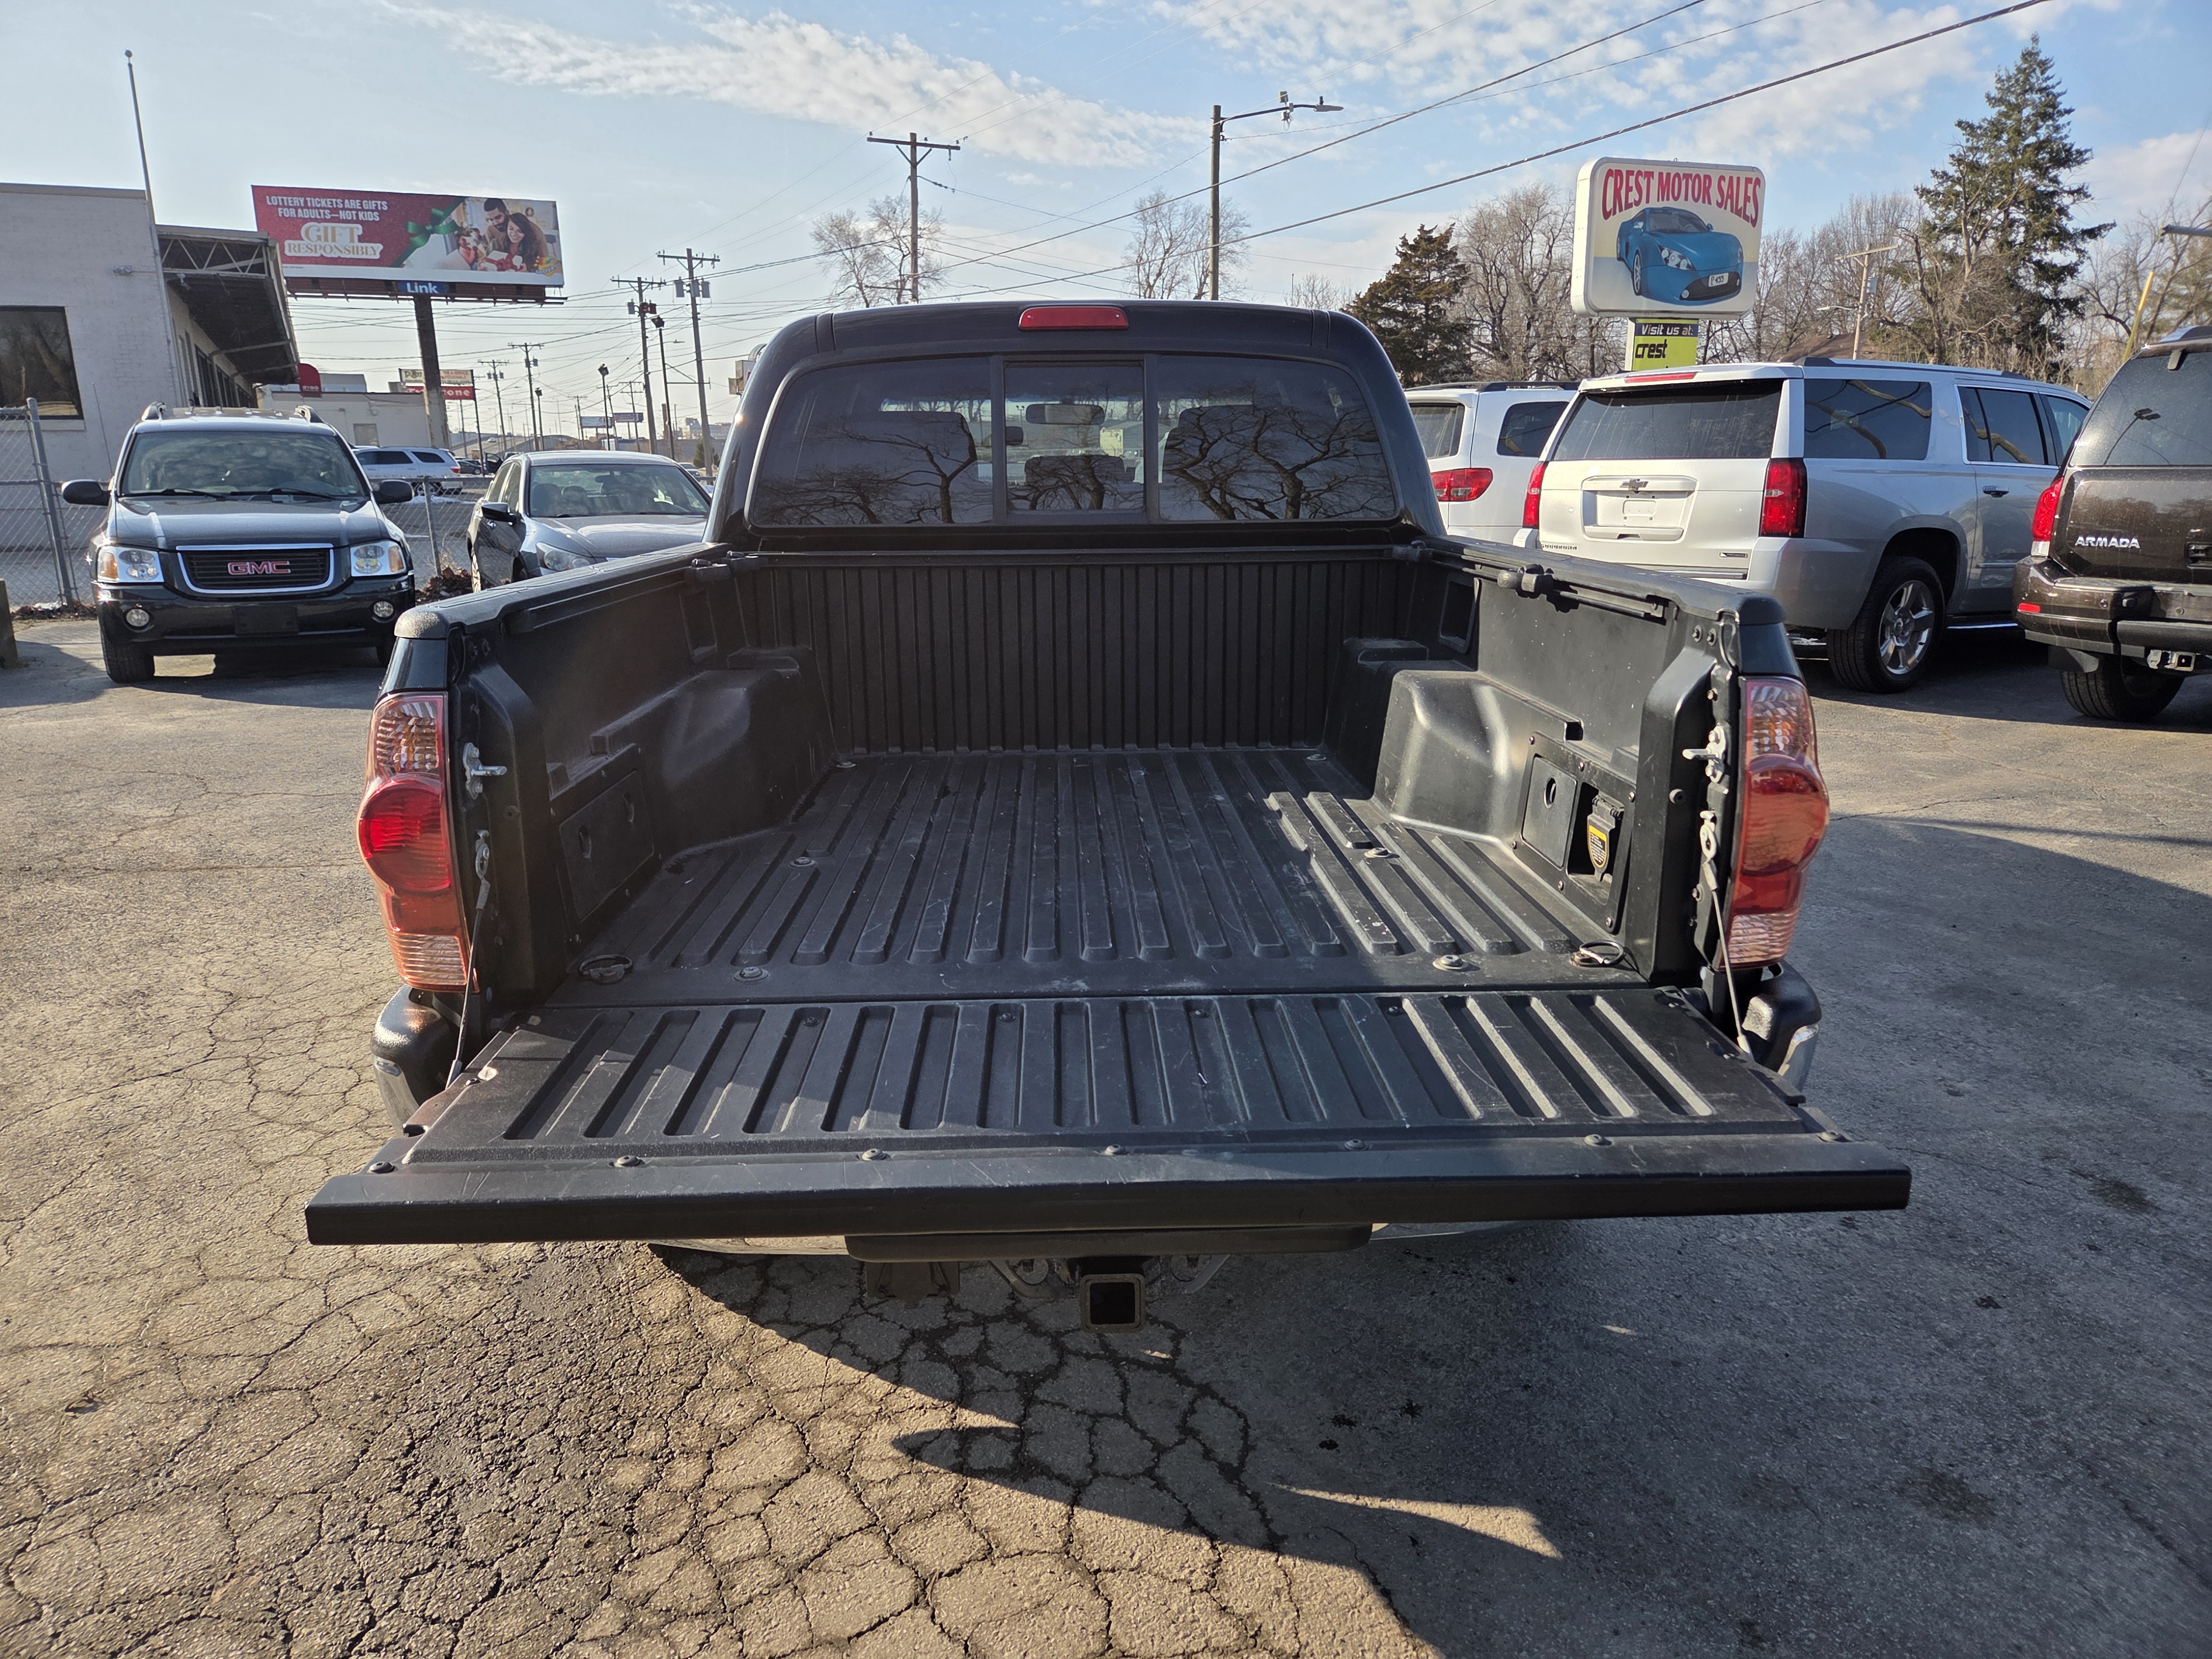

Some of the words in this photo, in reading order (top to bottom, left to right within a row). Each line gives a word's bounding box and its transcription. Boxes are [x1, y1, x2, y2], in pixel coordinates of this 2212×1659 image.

[266, 196, 304, 206] LOTTERY
[306, 197, 343, 208] TICKETS
[345, 199, 362, 209] ARE
[363, 200, 388, 210] GIFTS
[1602, 169, 1655, 221] CREST
[1657, 171, 1712, 205] MOTOR
[1716, 175, 1761, 228] SALES
[278, 208, 296, 217] FOR
[358, 211, 379, 221] KIDS
[304, 224, 359, 243] GIFT
[288, 243, 378, 256] RESPONSIBLY
[406, 282, 439, 294] Link
[1642, 324, 1664, 335] Visit
[1666, 326, 1680, 335] us
[1682, 325, 1693, 336] at:
[1635, 338, 1668, 358] crest
[2075, 536, 2141, 549] ARMADA
[228, 561, 291, 575] GMC
